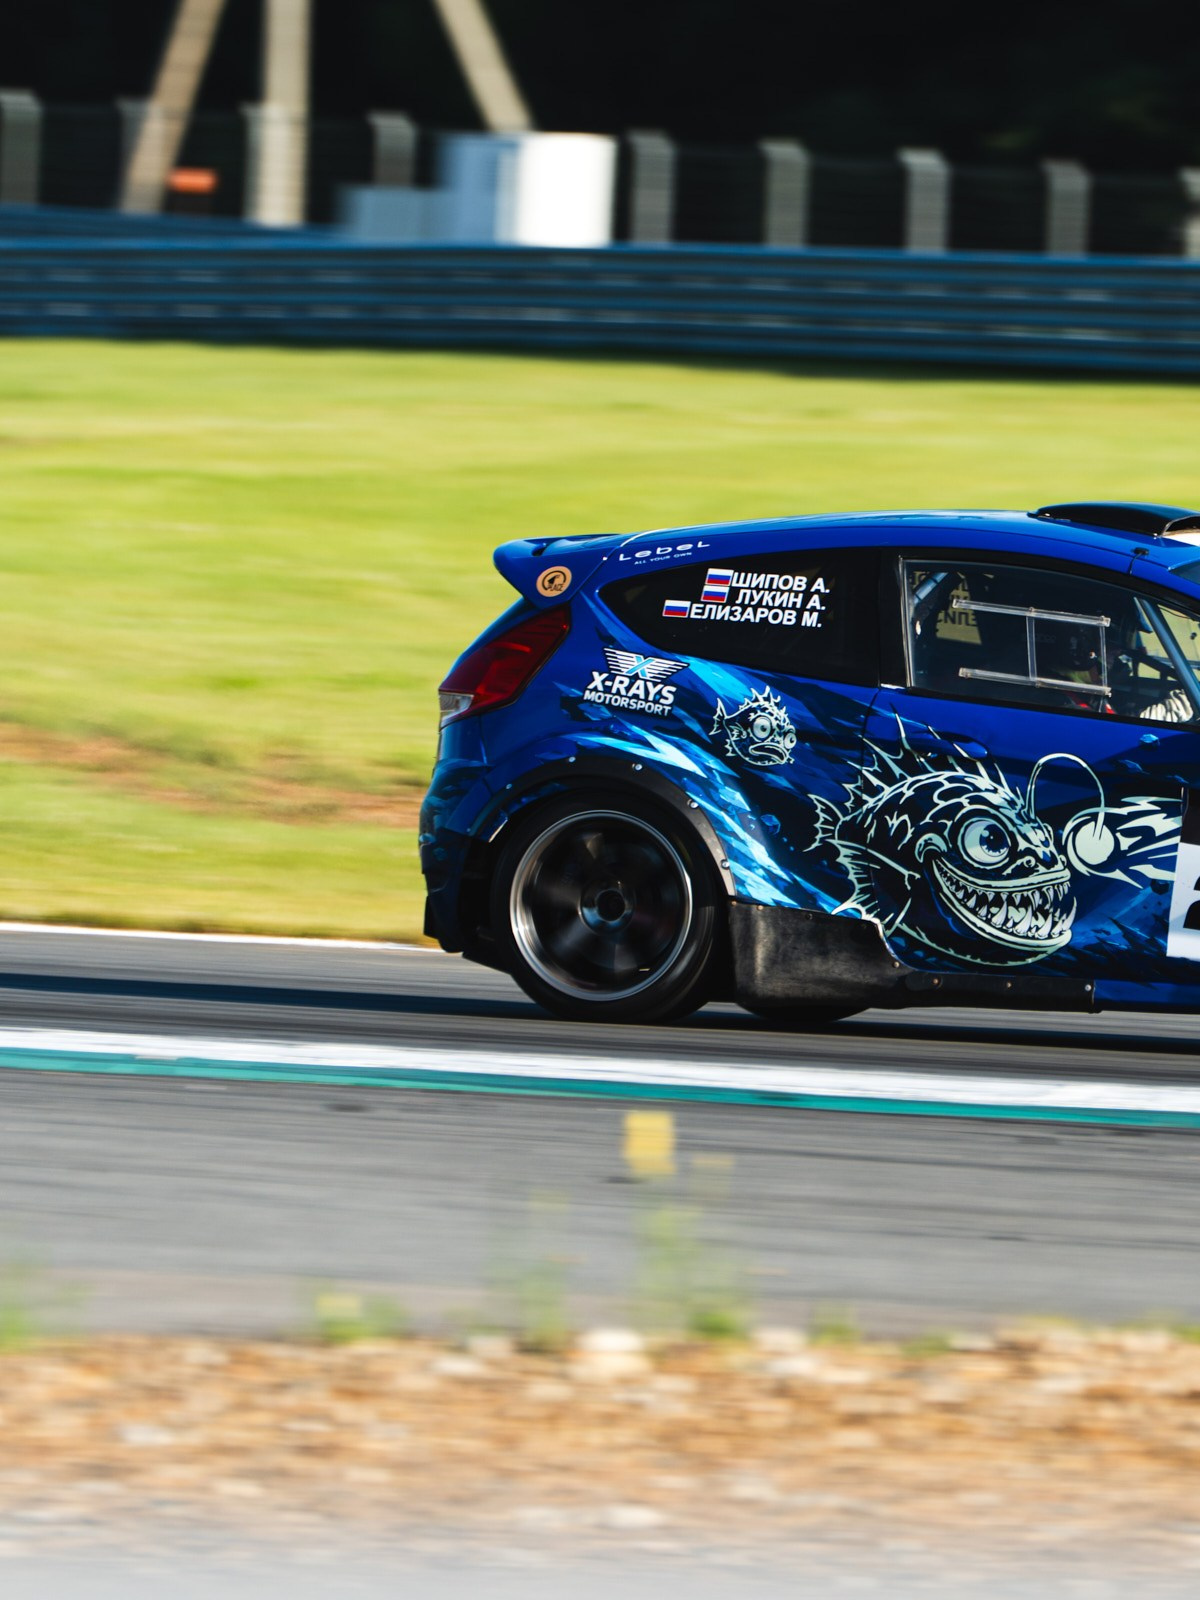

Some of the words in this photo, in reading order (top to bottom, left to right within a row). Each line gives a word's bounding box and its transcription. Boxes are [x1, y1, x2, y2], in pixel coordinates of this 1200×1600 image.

[731, 572, 808, 591] ШИПОВ
[735, 588, 803, 608] ЛУКИН
[690, 603, 797, 626] ЕЛИЗАРОВ
[587, 671, 677, 705] X-RAYS
[583, 690, 672, 716] MOTORSPORT
